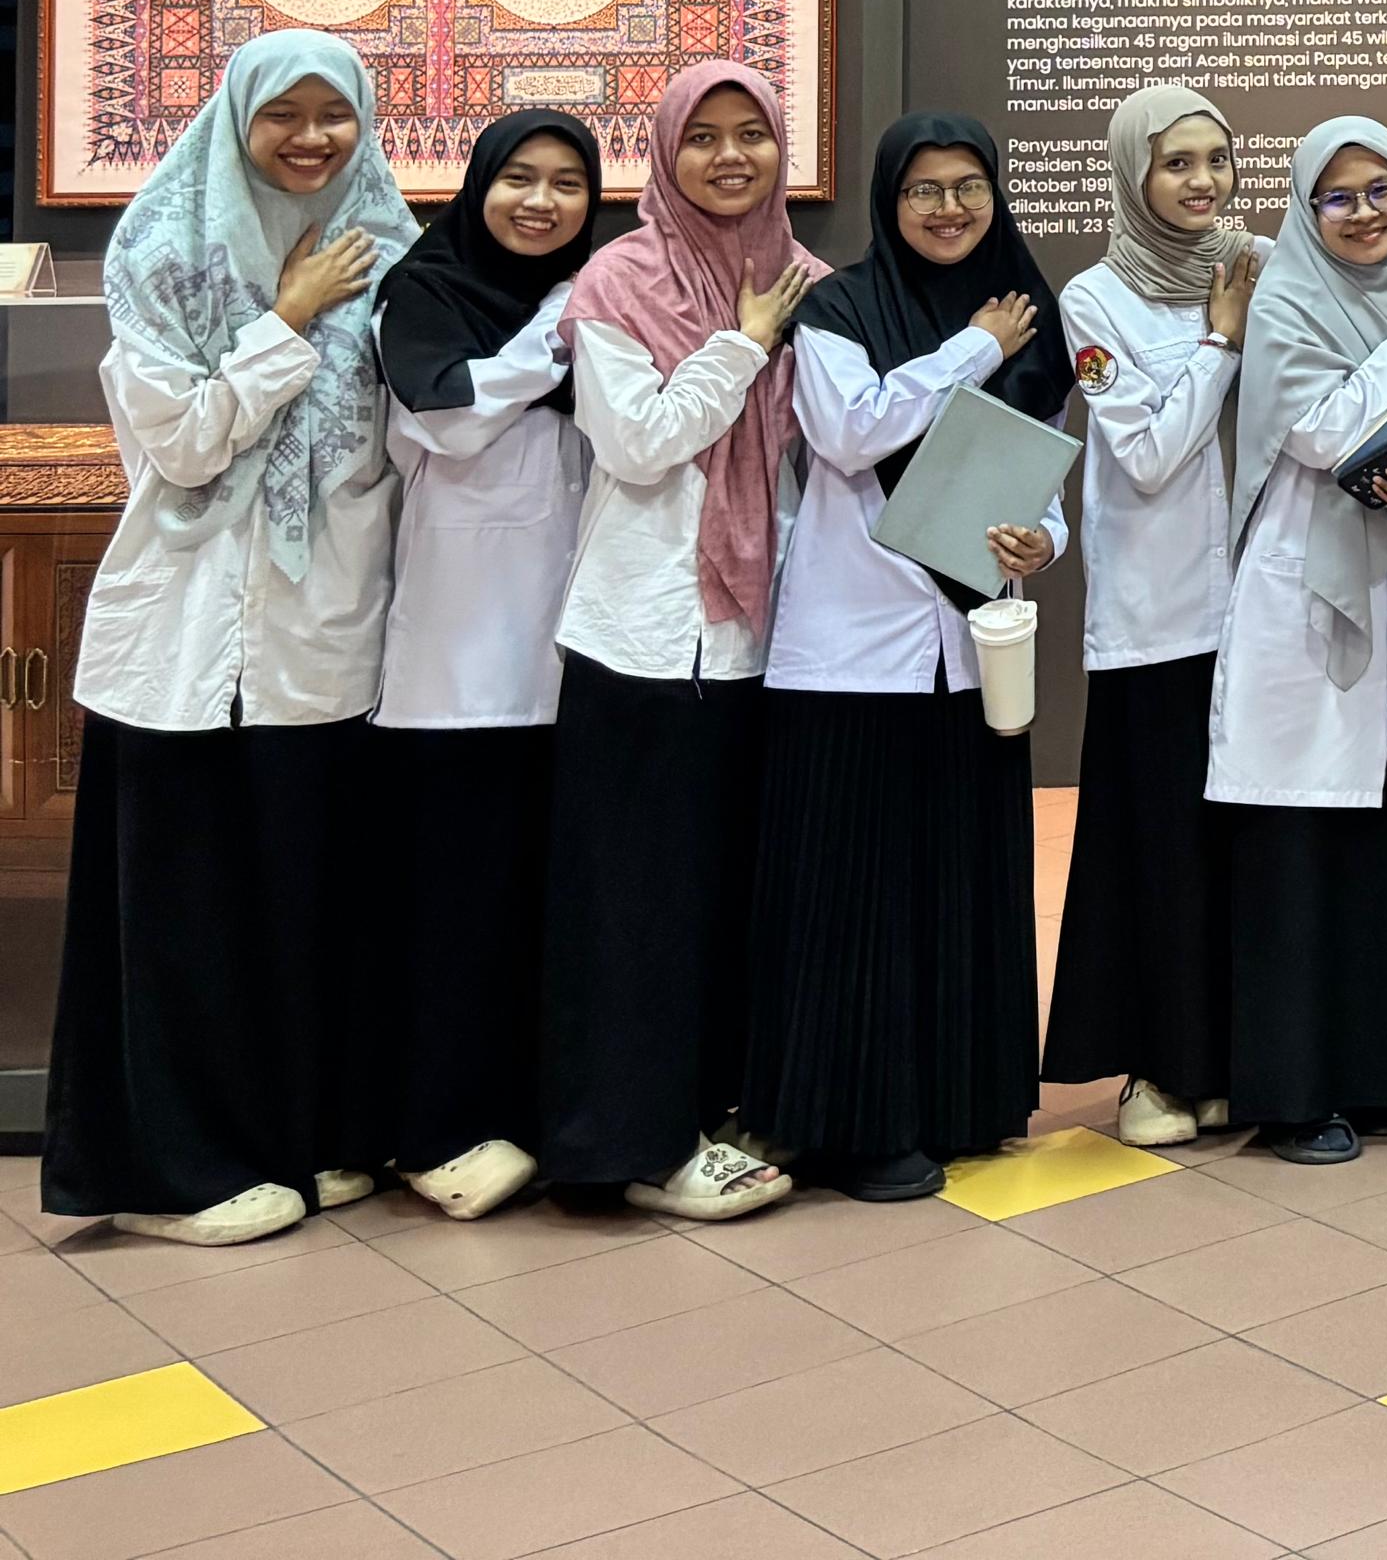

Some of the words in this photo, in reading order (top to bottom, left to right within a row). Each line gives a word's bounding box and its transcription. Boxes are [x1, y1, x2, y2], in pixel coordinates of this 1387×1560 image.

[1008, 96, 1083, 111] manusia
[1087, 95, 1122, 110] dan
[1008, 157, 1082, 173] Presiden
[1008, 177, 1078, 193] Oktober
[1008, 198, 1090, 214] dilakukan
[1256, 194, 1290, 214] pad
[1016, 218, 1064, 238] tiqlal
[1082, 218, 1103, 233] 23
